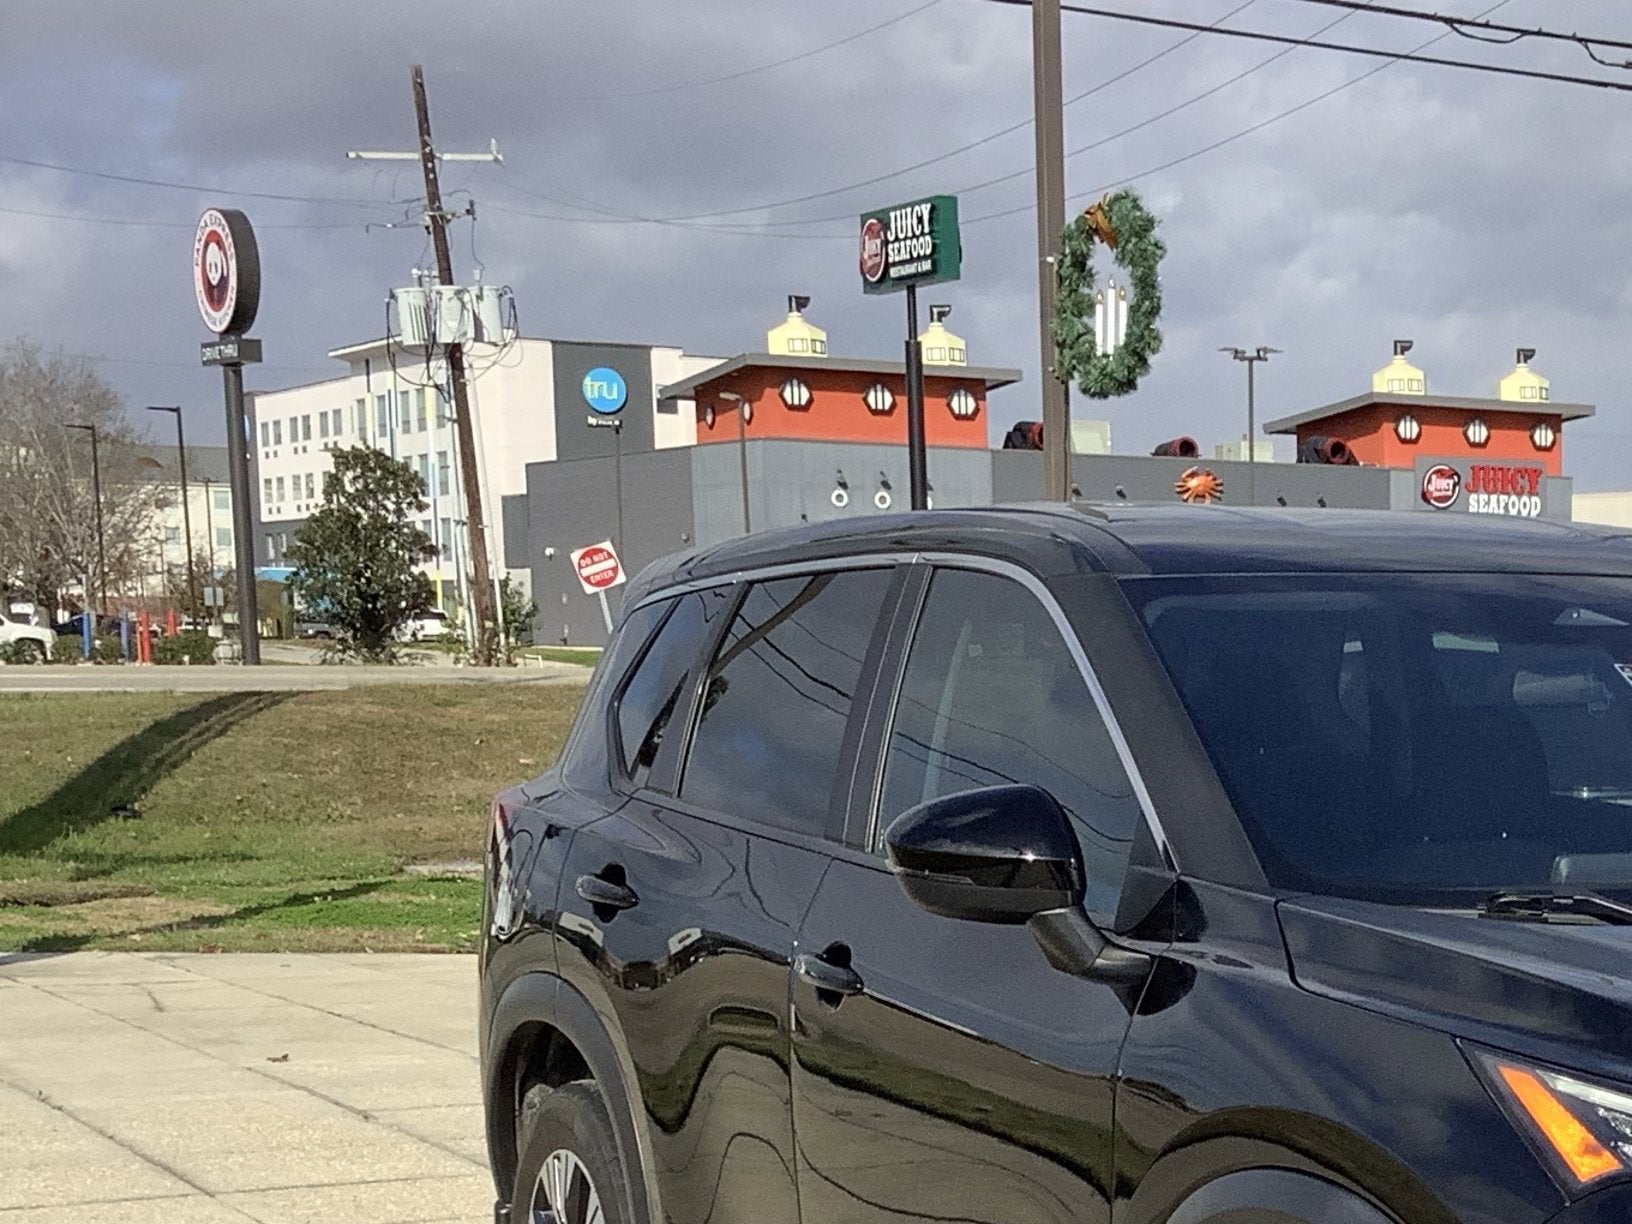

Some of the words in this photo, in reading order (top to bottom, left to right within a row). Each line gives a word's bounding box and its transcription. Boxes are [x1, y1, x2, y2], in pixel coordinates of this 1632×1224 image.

[887, 203, 932, 242] JUICY
[887, 234, 932, 263] SEAFOOD
[583, 376, 618, 400] tru
[1465, 465, 1542, 496] JUICY
[1468, 493, 1542, 518] SEAFOOD
[580, 557, 592, 568] DO
[592, 551, 609, 562] NOT
[590, 569, 615, 584] ENTER
